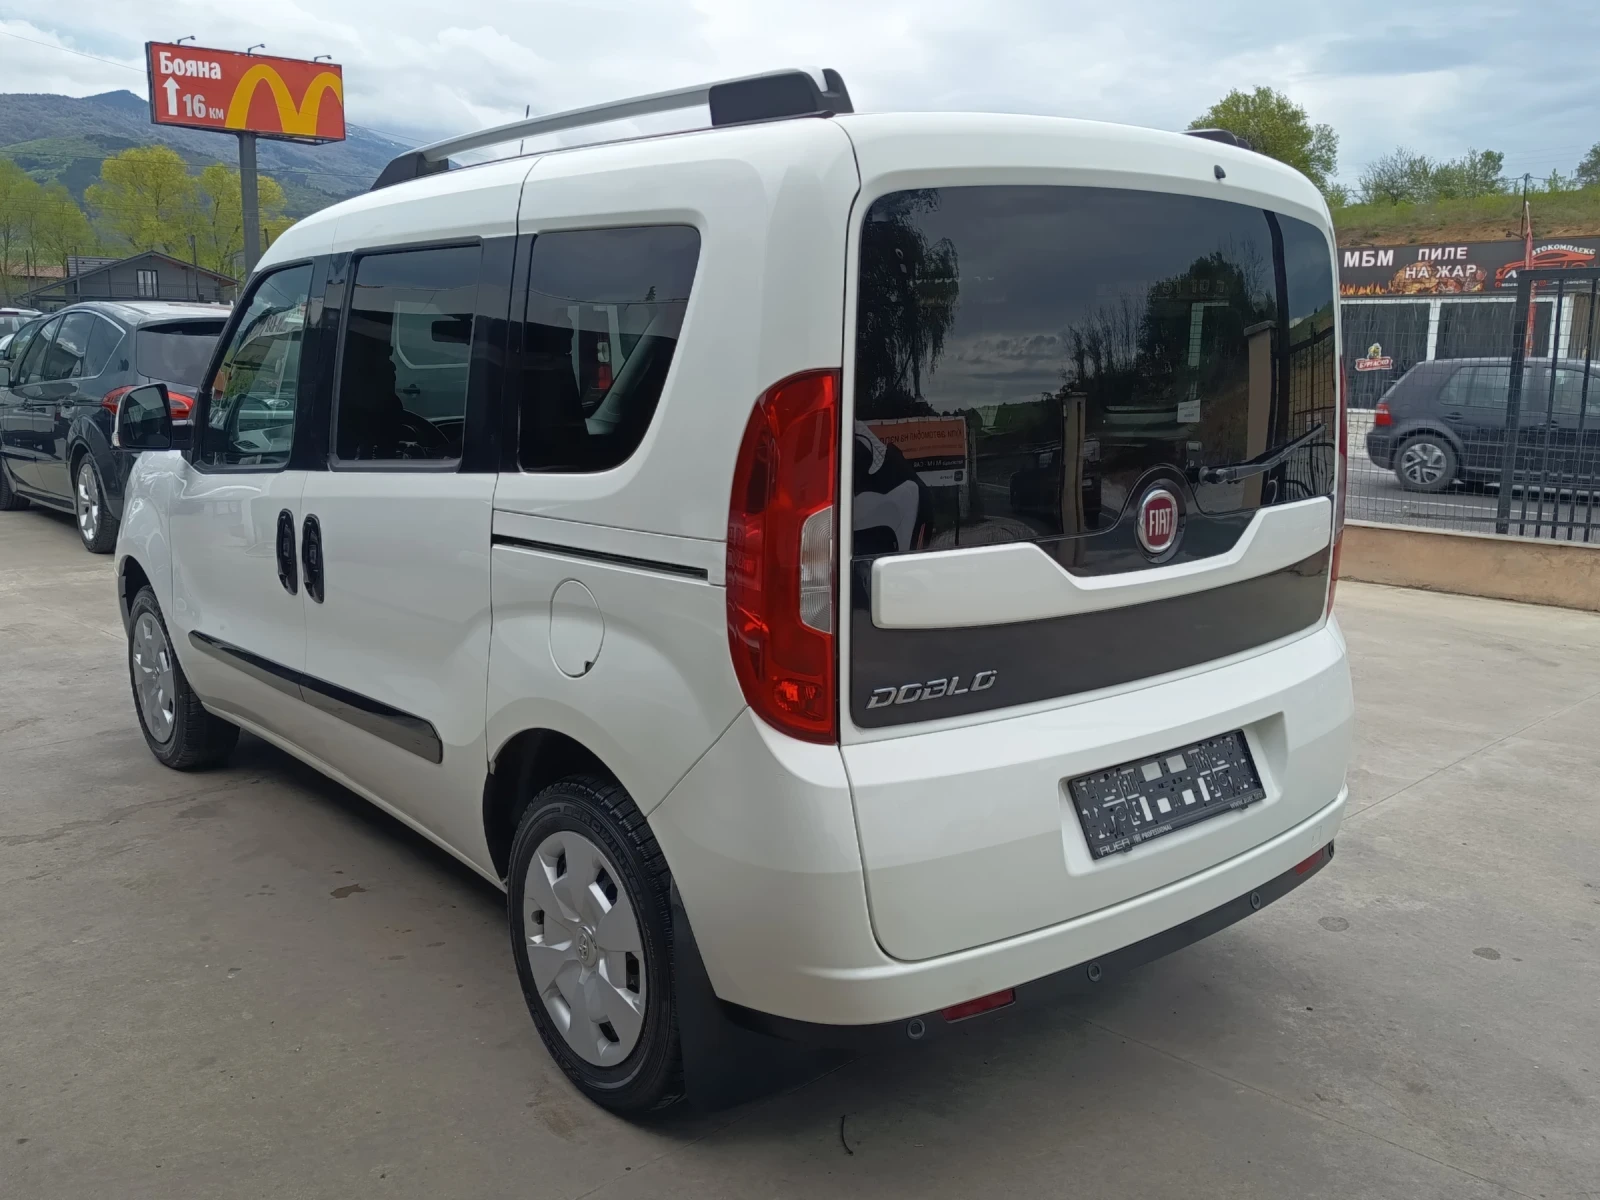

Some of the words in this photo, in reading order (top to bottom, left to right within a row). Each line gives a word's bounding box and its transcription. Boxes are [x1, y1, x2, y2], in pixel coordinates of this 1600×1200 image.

[159, 51, 222, 80] Бояна
[182, 93, 207, 118] 16
[1417, 246, 1469, 261] ПИЛЕ
[1532, 243, 1596, 256] ТОКОМПЛЕКС
[1343, 249, 1395, 268] МБМ
[1405, 265, 1430, 279] НА
[1436, 264, 1478, 278] ЖАР
[1148, 508, 1172, 537] FIAT
[1141, 824, 1173, 840] PROFESSIONAL
